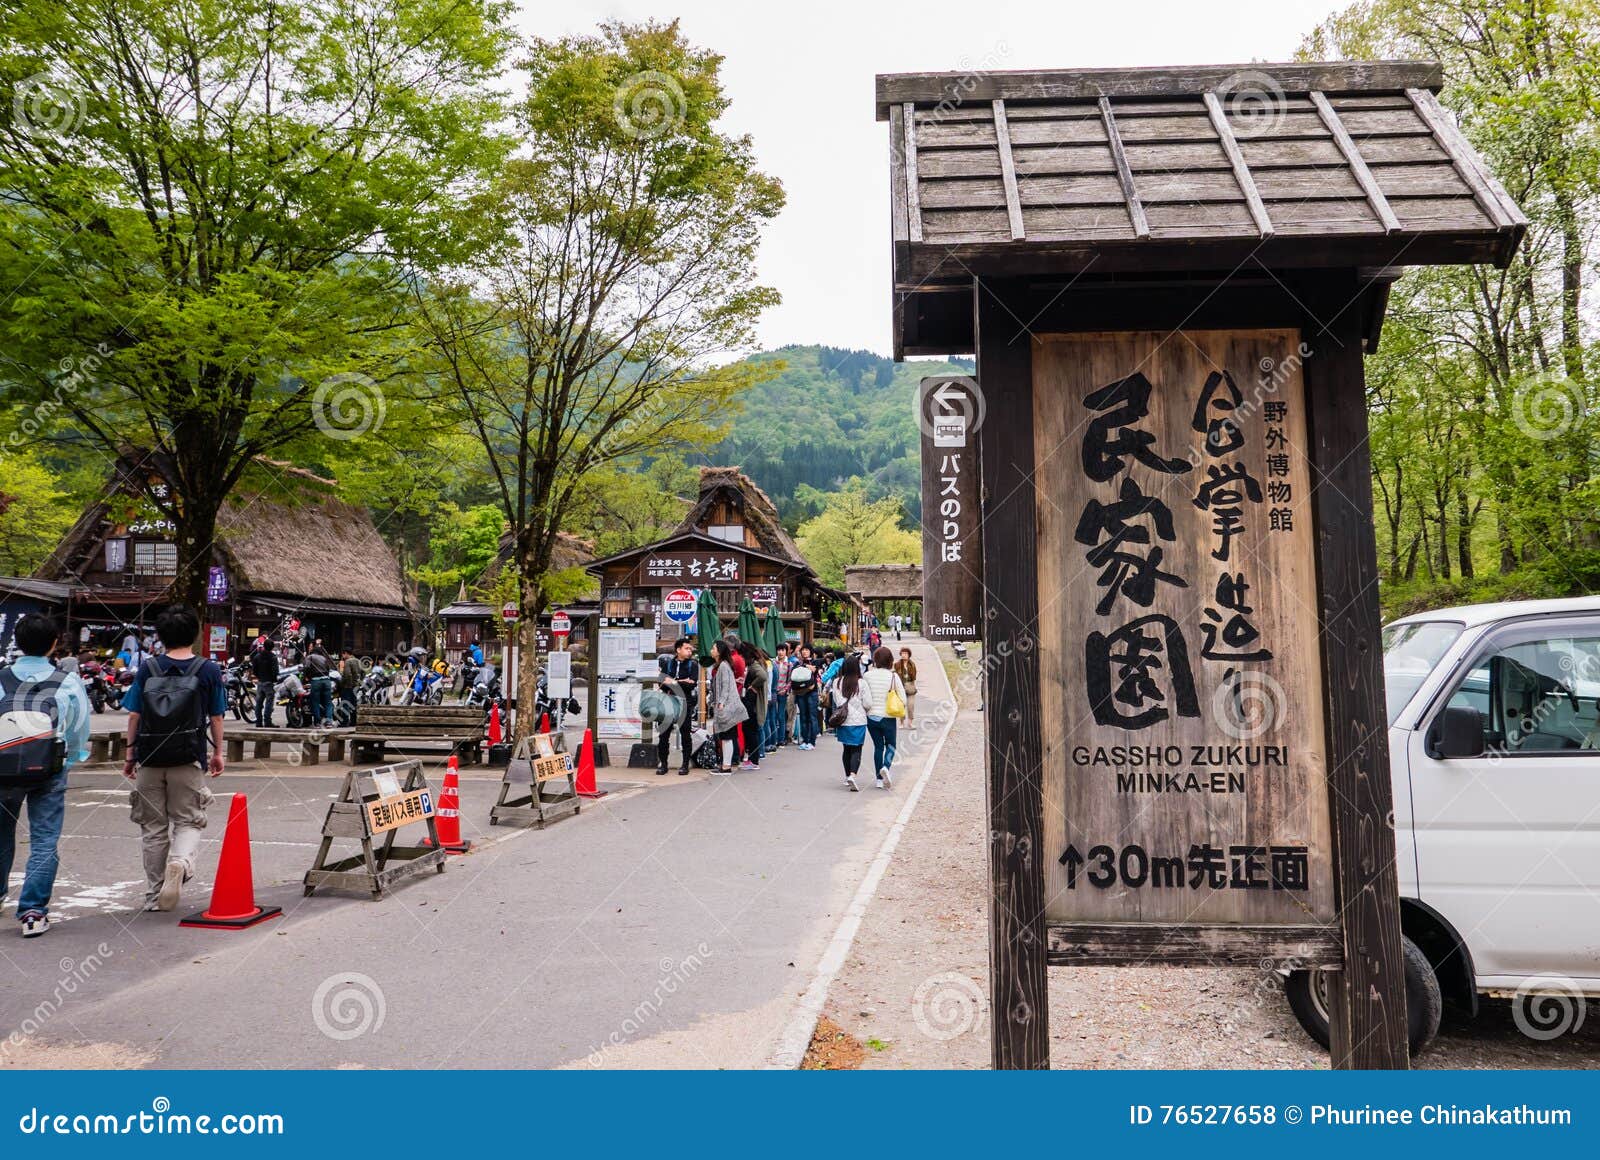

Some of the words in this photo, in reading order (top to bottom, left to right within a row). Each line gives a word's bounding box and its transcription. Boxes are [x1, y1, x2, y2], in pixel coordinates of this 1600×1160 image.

[1263, 401, 1294, 532] 野外博物館
[939, 453, 962, 562] バスのりば
[1074, 372, 1201, 730] 民家園
[669, 602, 693, 610] 白川郷
[943, 613, 962, 624] Bus
[929, 625, 976, 636] Terminal
[1073, 746, 1183, 767] GASSHO
[1191, 746, 1288, 767] ZUKURI
[1117, 773, 1245, 793] MINKA-EN
[372, 796, 422, 828] 定期バス専用
